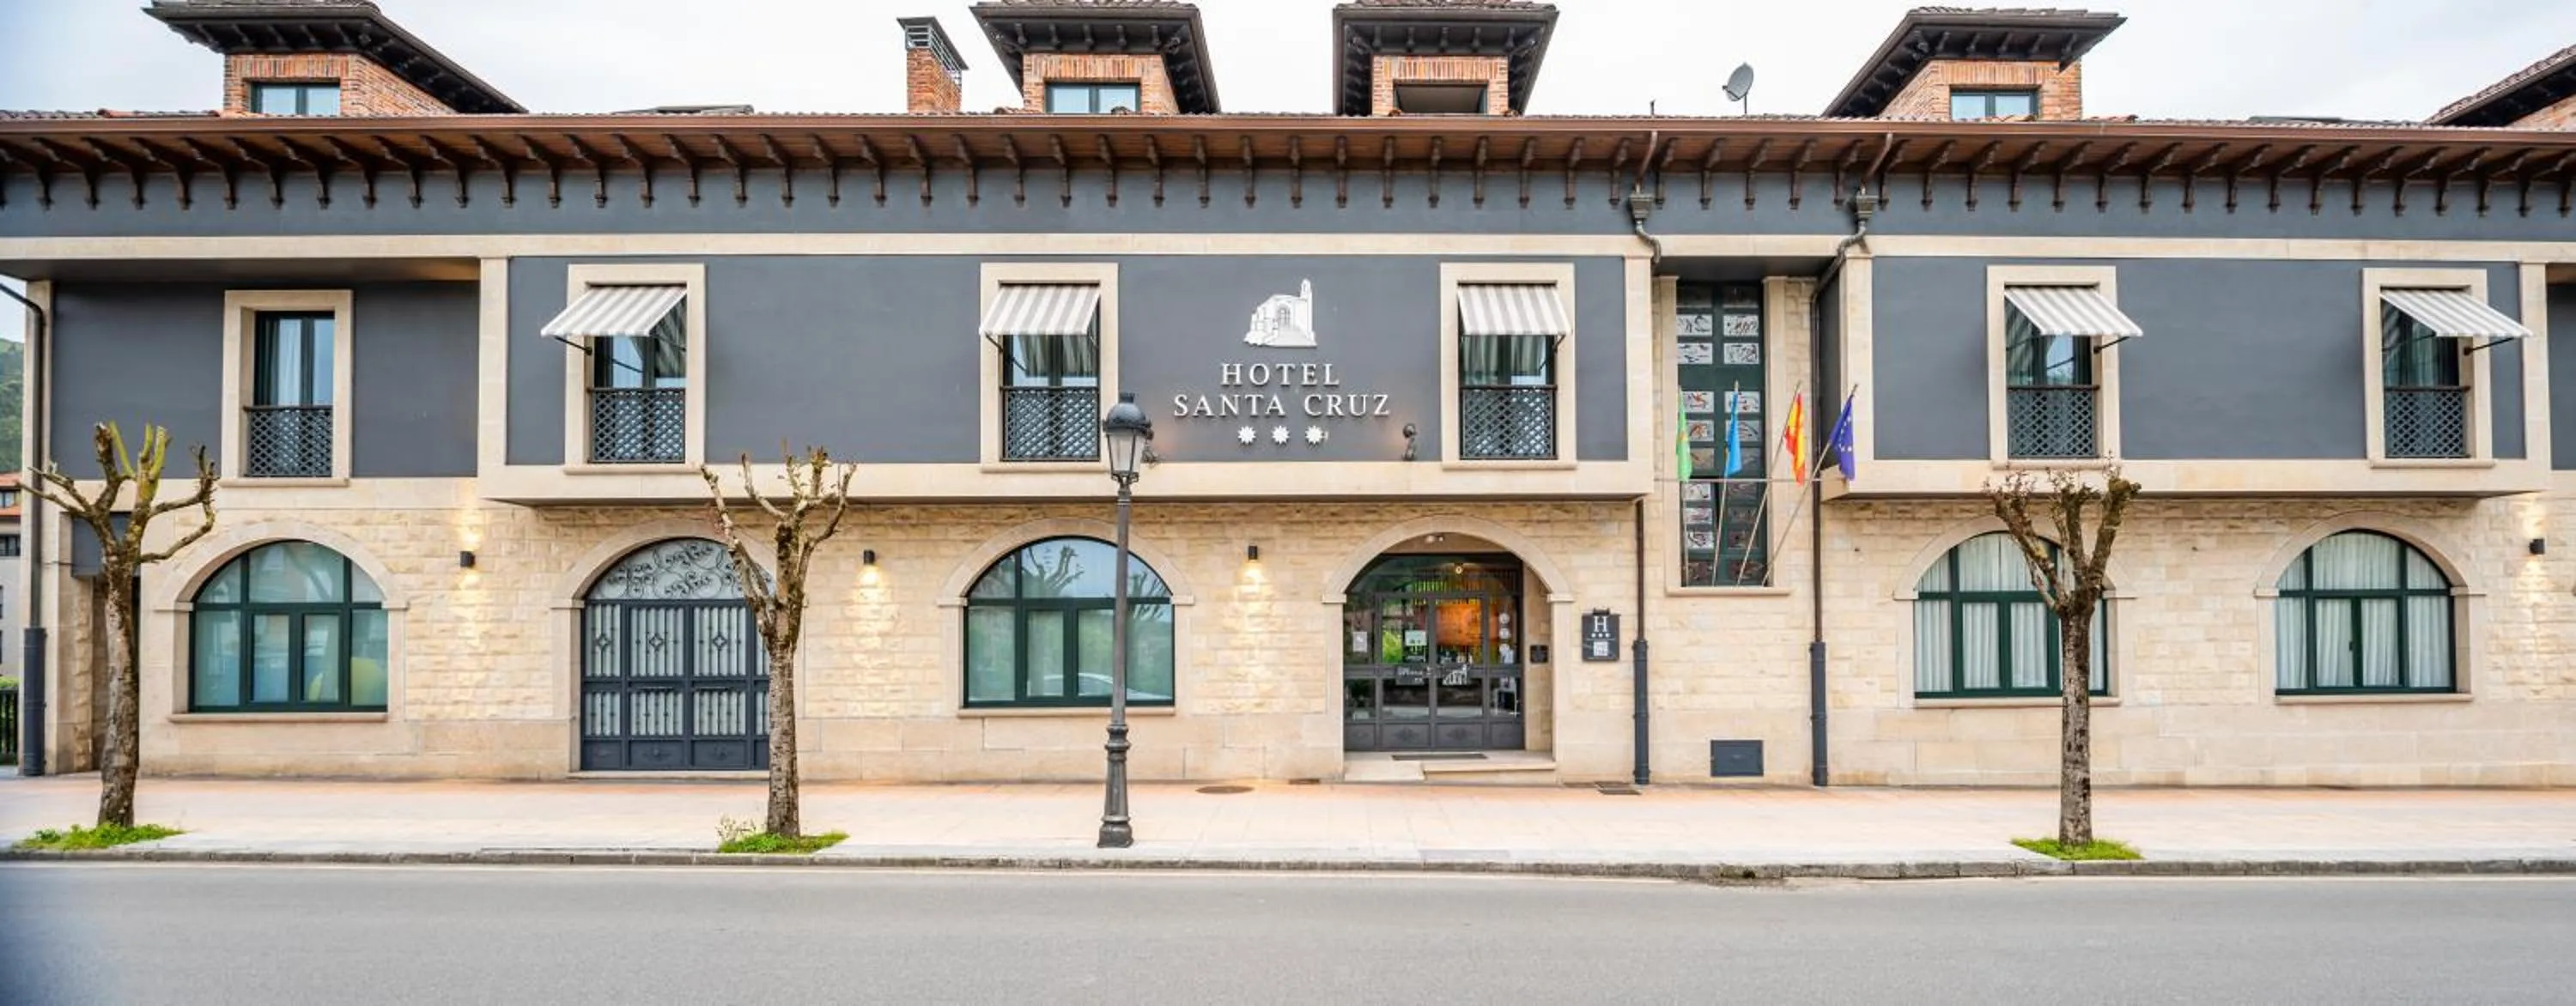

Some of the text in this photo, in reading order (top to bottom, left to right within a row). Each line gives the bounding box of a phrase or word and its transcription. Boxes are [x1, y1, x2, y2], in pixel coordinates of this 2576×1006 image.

[1221, 362, 1340, 387] HOTEL
[1173, 393, 1391, 418] SANTA CRUZ
[1593, 615, 1609, 633] H
